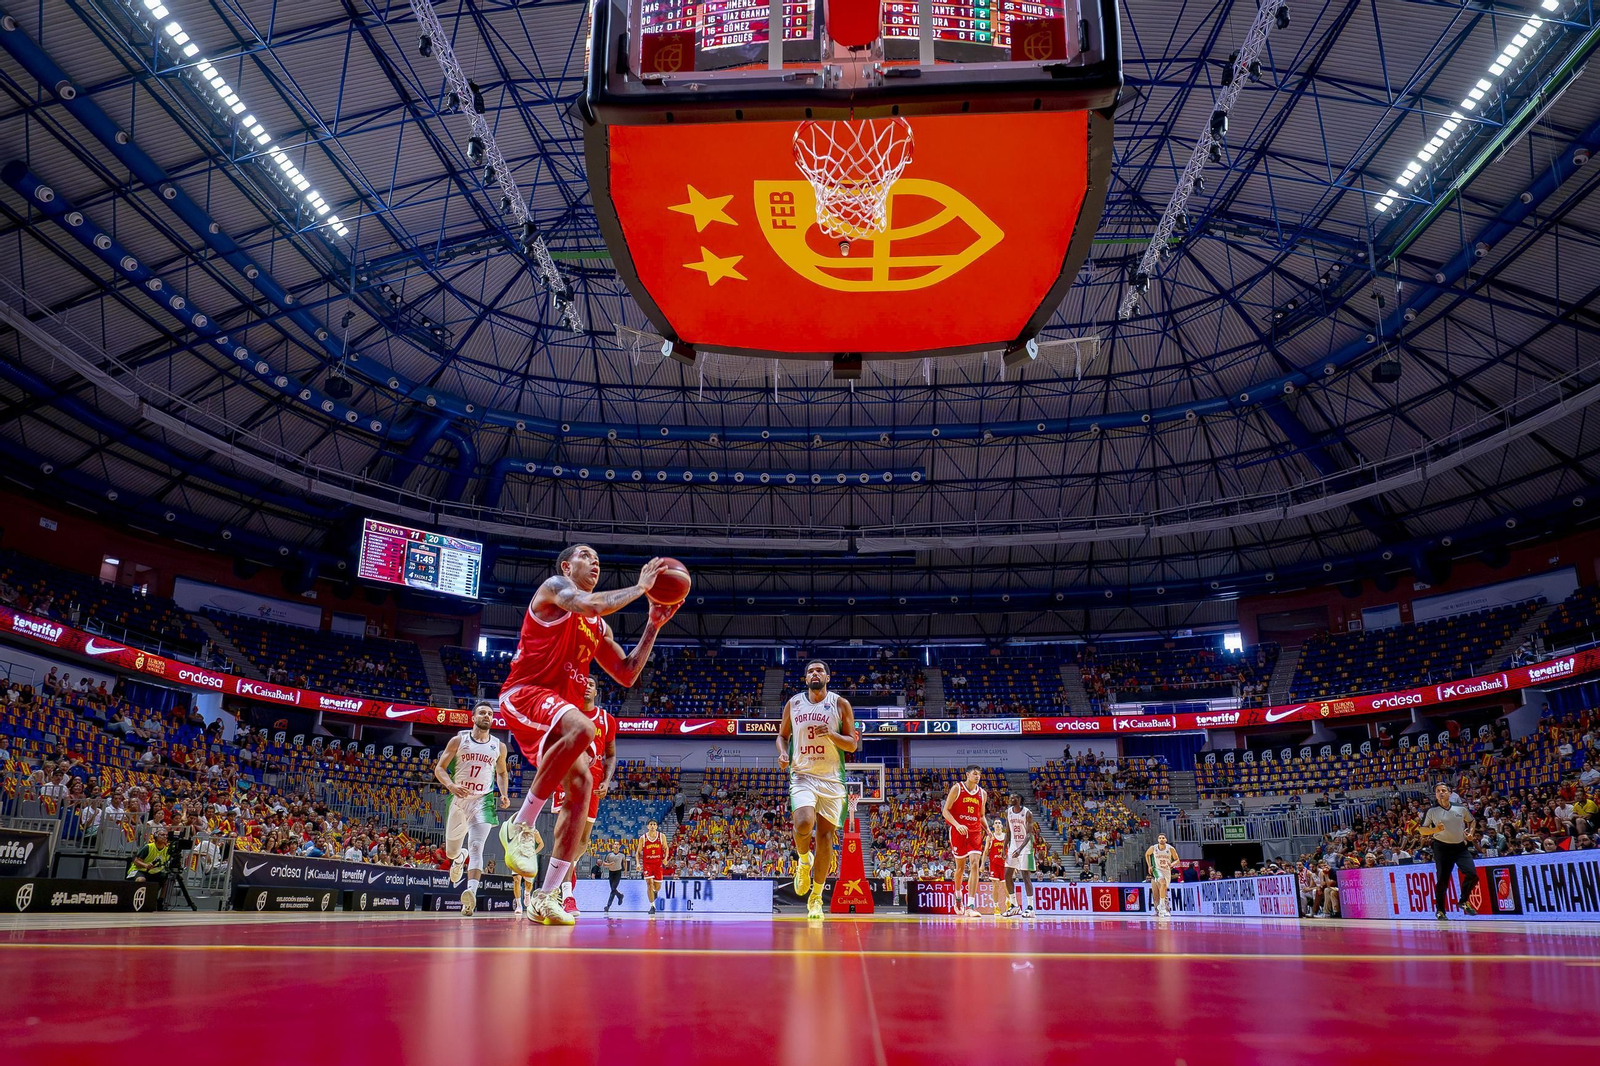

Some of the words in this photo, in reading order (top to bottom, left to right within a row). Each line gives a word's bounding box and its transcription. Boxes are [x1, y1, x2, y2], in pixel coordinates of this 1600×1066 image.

[796, 6, 802, 14] 0
[980, 10, 986, 18] 2
[723, 22, 750, 32] GÓMEZ
[796, 18, 802, 26] 0
[706, 38, 715, 46] 17
[722, 33, 754, 44] NOGUÉS
[796, 30, 802, 38] 0
[892, 28, 900, 36] 11
[980, 34, 986, 42] 0
[769, 191, 796, 230] FEB
[410, 531, 420, 540] 11
[428, 535, 439, 544] 20
[415, 554, 434, 564] 1:49
[178, 670, 224, 688] endesa
[1456, 678, 1503, 695] CaixaBank
[254, 685, 295, 702] CaixaBank
[1372, 694, 1422, 709] endesa
[794, 712, 830, 725] PORTUGAL
[1130, 719, 1171, 728] CaixaBank
[745, 722, 777, 732] ESPAÑA
[906, 721, 920, 732] 17
[933, 722, 950, 732] 20
[971, 722, 1016, 731] PORTUGAL
[1056, 720, 1100, 731] endesa
[800, 745, 825, 754] una
[461, 752, 495, 766] PORTUGAL
[470, 766, 482, 778] 17
[270, 864, 301, 879] endesa
[1035, 882, 1089, 910] ESPAÑA
[1406, 872, 1460, 912] ESPAA
[51, 892, 118, 906] #LaFamilia
